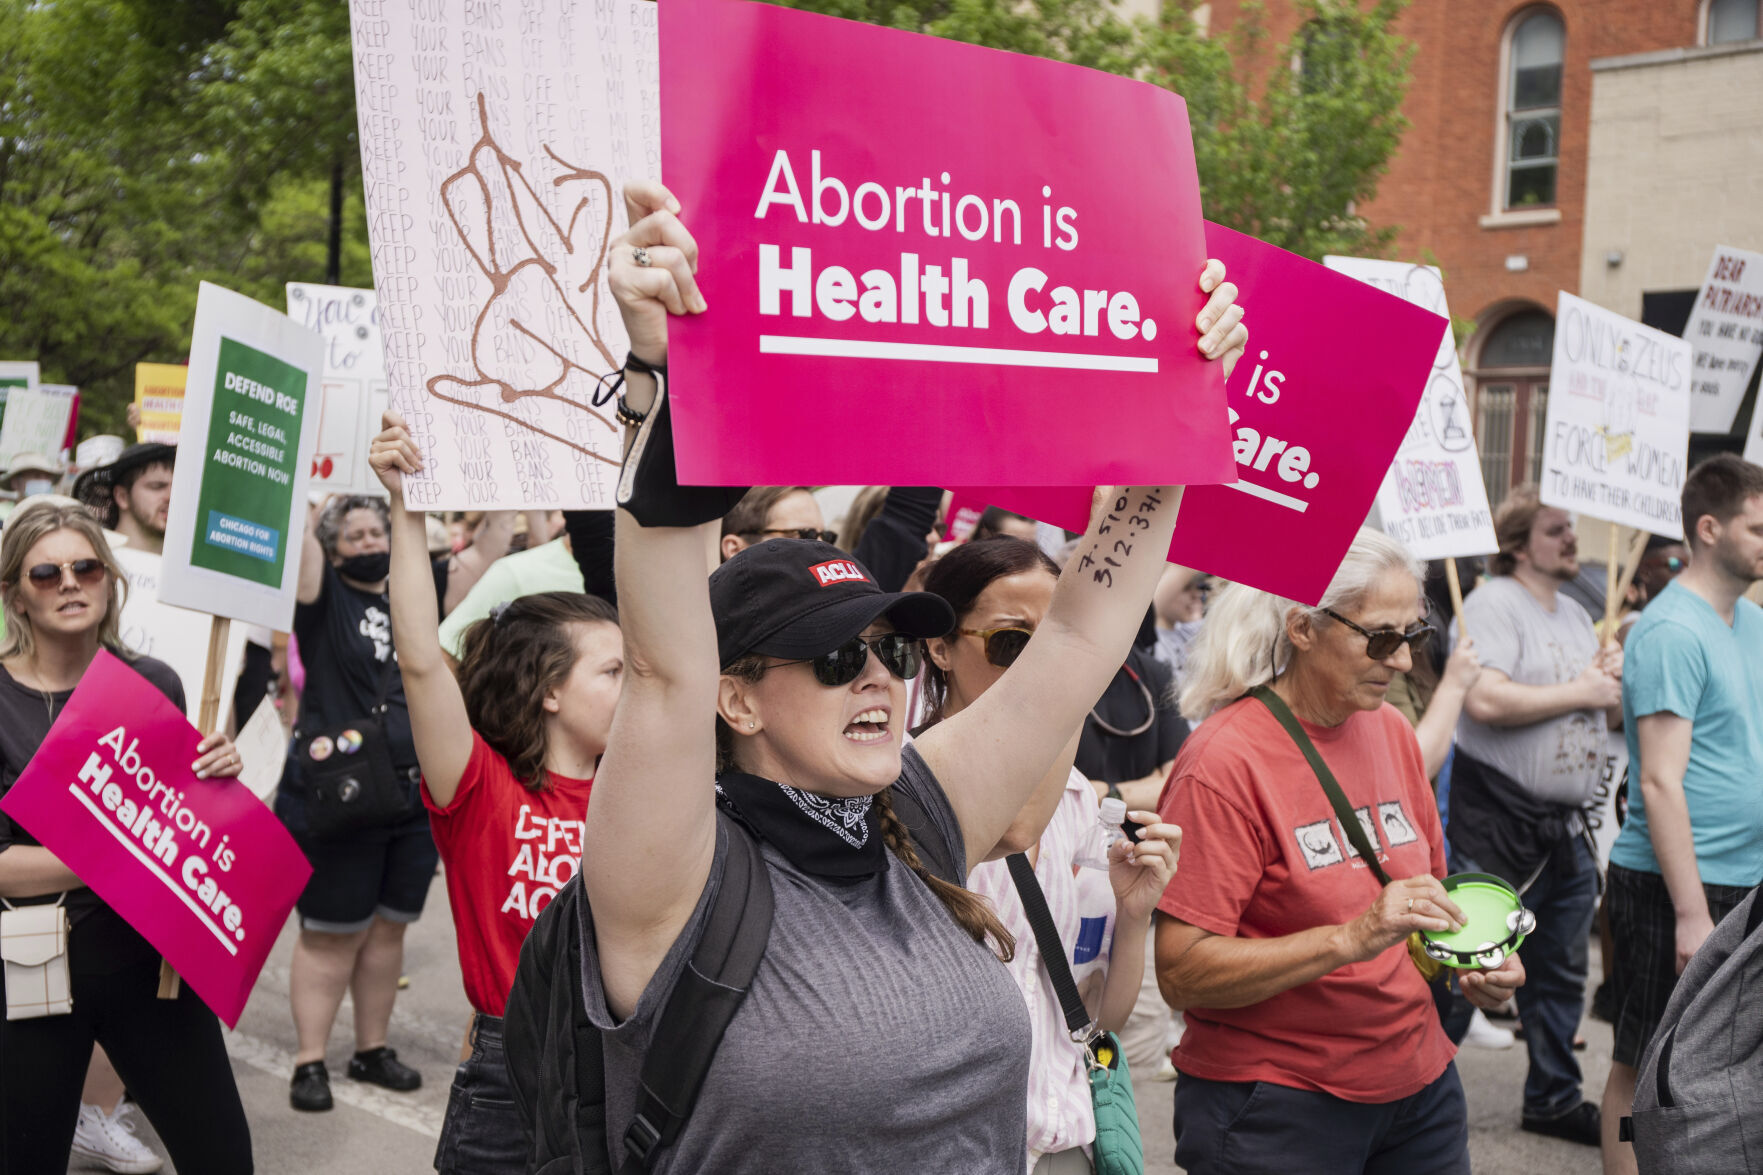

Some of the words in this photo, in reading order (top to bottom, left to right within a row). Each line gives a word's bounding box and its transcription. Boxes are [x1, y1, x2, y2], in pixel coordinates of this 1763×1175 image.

[409, 0, 449, 22] YOUR
[354, 20, 391, 48] KEEP
[411, 23, 449, 51] YOUR
[462, 30, 507, 67] BANS
[357, 52, 396, 80] KEEP
[412, 54, 450, 84] YOUR
[523, 72, 551, 102] OFF
[359, 80, 399, 114] KEEP
[416, 87, 454, 118] YOUR
[524, 102, 558, 127] OFF
[361, 115, 401, 139] KEEP
[418, 117, 460, 144] YOUR
[363, 138, 403, 159] KEEP
[365, 156, 407, 180] KEEP
[366, 181, 410, 211] KEEP
[754, 149, 1021, 245] Abortion
[1042, 184, 1079, 251] is
[371, 211, 414, 244] KEEP
[373, 244, 416, 275] KEEP
[431, 248, 474, 273] YOUR
[377, 274, 419, 304] KEEP
[434, 275, 479, 305] YOUR
[759, 243, 989, 329] Health
[1007, 266, 1157, 341] Care.
[379, 303, 423, 331] KEEP
[384, 331, 426, 361] KEEP
[439, 335, 470, 363] YOU
[1565, 307, 1621, 372] ONLY
[1631, 333, 1683, 391] ZEUS
[387, 359, 428, 388] KEEP
[1246, 350, 1286, 404] is
[224, 371, 275, 406] DEFEND
[275, 391, 299, 416] ROE
[390, 387, 430, 411] KEEP
[229, 410, 256, 433] SAFE,
[258, 421, 287, 445] LEGAL,
[402, 412, 434, 435] EEP
[449, 412, 488, 436] YOUR
[567, 418, 596, 441] OFF
[227, 431, 285, 463] ACCESSIBLE
[453, 437, 491, 462] YOUR
[511, 440, 549, 461] BANS
[1228, 406, 1319, 489] are.
[213, 448, 267, 477] ABORTION
[267, 466, 289, 485] NOW
[459, 460, 494, 481] YOUR
[516, 460, 553, 481] BANS
[576, 462, 603, 483] OFF
[1628, 441, 1682, 488] WOMEN
[407, 481, 442, 504] KEEP
[463, 481, 500, 504] YOUR
[521, 480, 559, 503] BANS
[581, 482, 607, 504] OFF
[1393, 459, 1464, 514] WOMEN
[1550, 468, 1569, 496] TO
[1574, 476, 1597, 502] HAVE
[1600, 483, 1631, 509] THEIR
[1634, 493, 1681, 523] CHILDREN
[209, 530, 249, 550] ABORTION
[249, 541, 274, 558] RIGHTS
[219, 517, 254, 536] CHICAGO
[255, 528, 270, 541] FOR
[816, 562, 864, 584] ACLU
[97, 726, 211, 849] Abortion
[211, 834, 236, 872] is
[77, 751, 179, 867] Health
[181, 855, 245, 942] Care.
